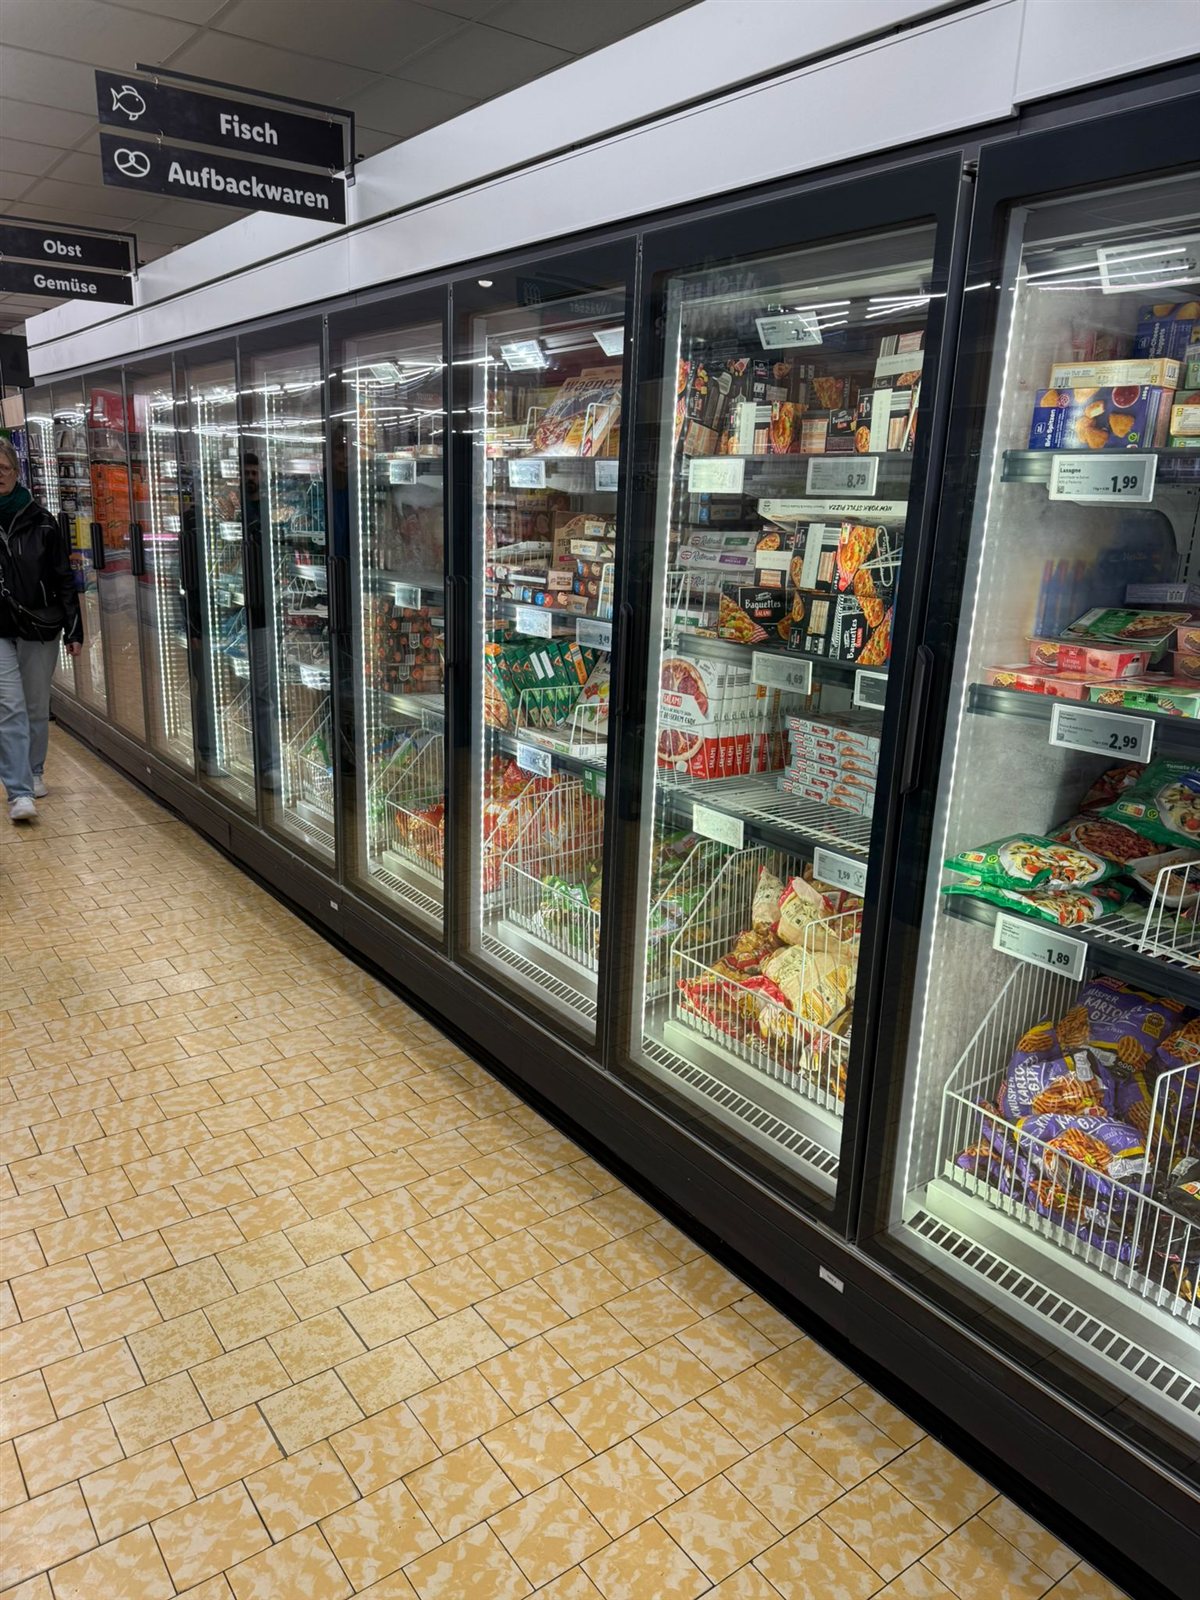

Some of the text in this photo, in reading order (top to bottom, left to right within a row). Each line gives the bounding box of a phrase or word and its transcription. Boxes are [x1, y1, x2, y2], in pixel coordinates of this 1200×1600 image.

[219, 113, 279, 145] Fisch
[167, 162, 330, 210] Aufbackwaren
[43, 240, 82, 258] Obst
[33, 274, 97, 294] Gemüse
[846, 474, 866, 489] 8.79
[1111, 475, 1138, 493] 1.99
[744, 599, 781, 609] Baguettes
[846, 618, 858, 659] Baguettes
[786, 672, 803, 686] 4.69
[1109, 733, 1138, 750] 2.99
[708, 747, 716, 768] SALAMI
[1046, 949, 1070, 966] 1.89
